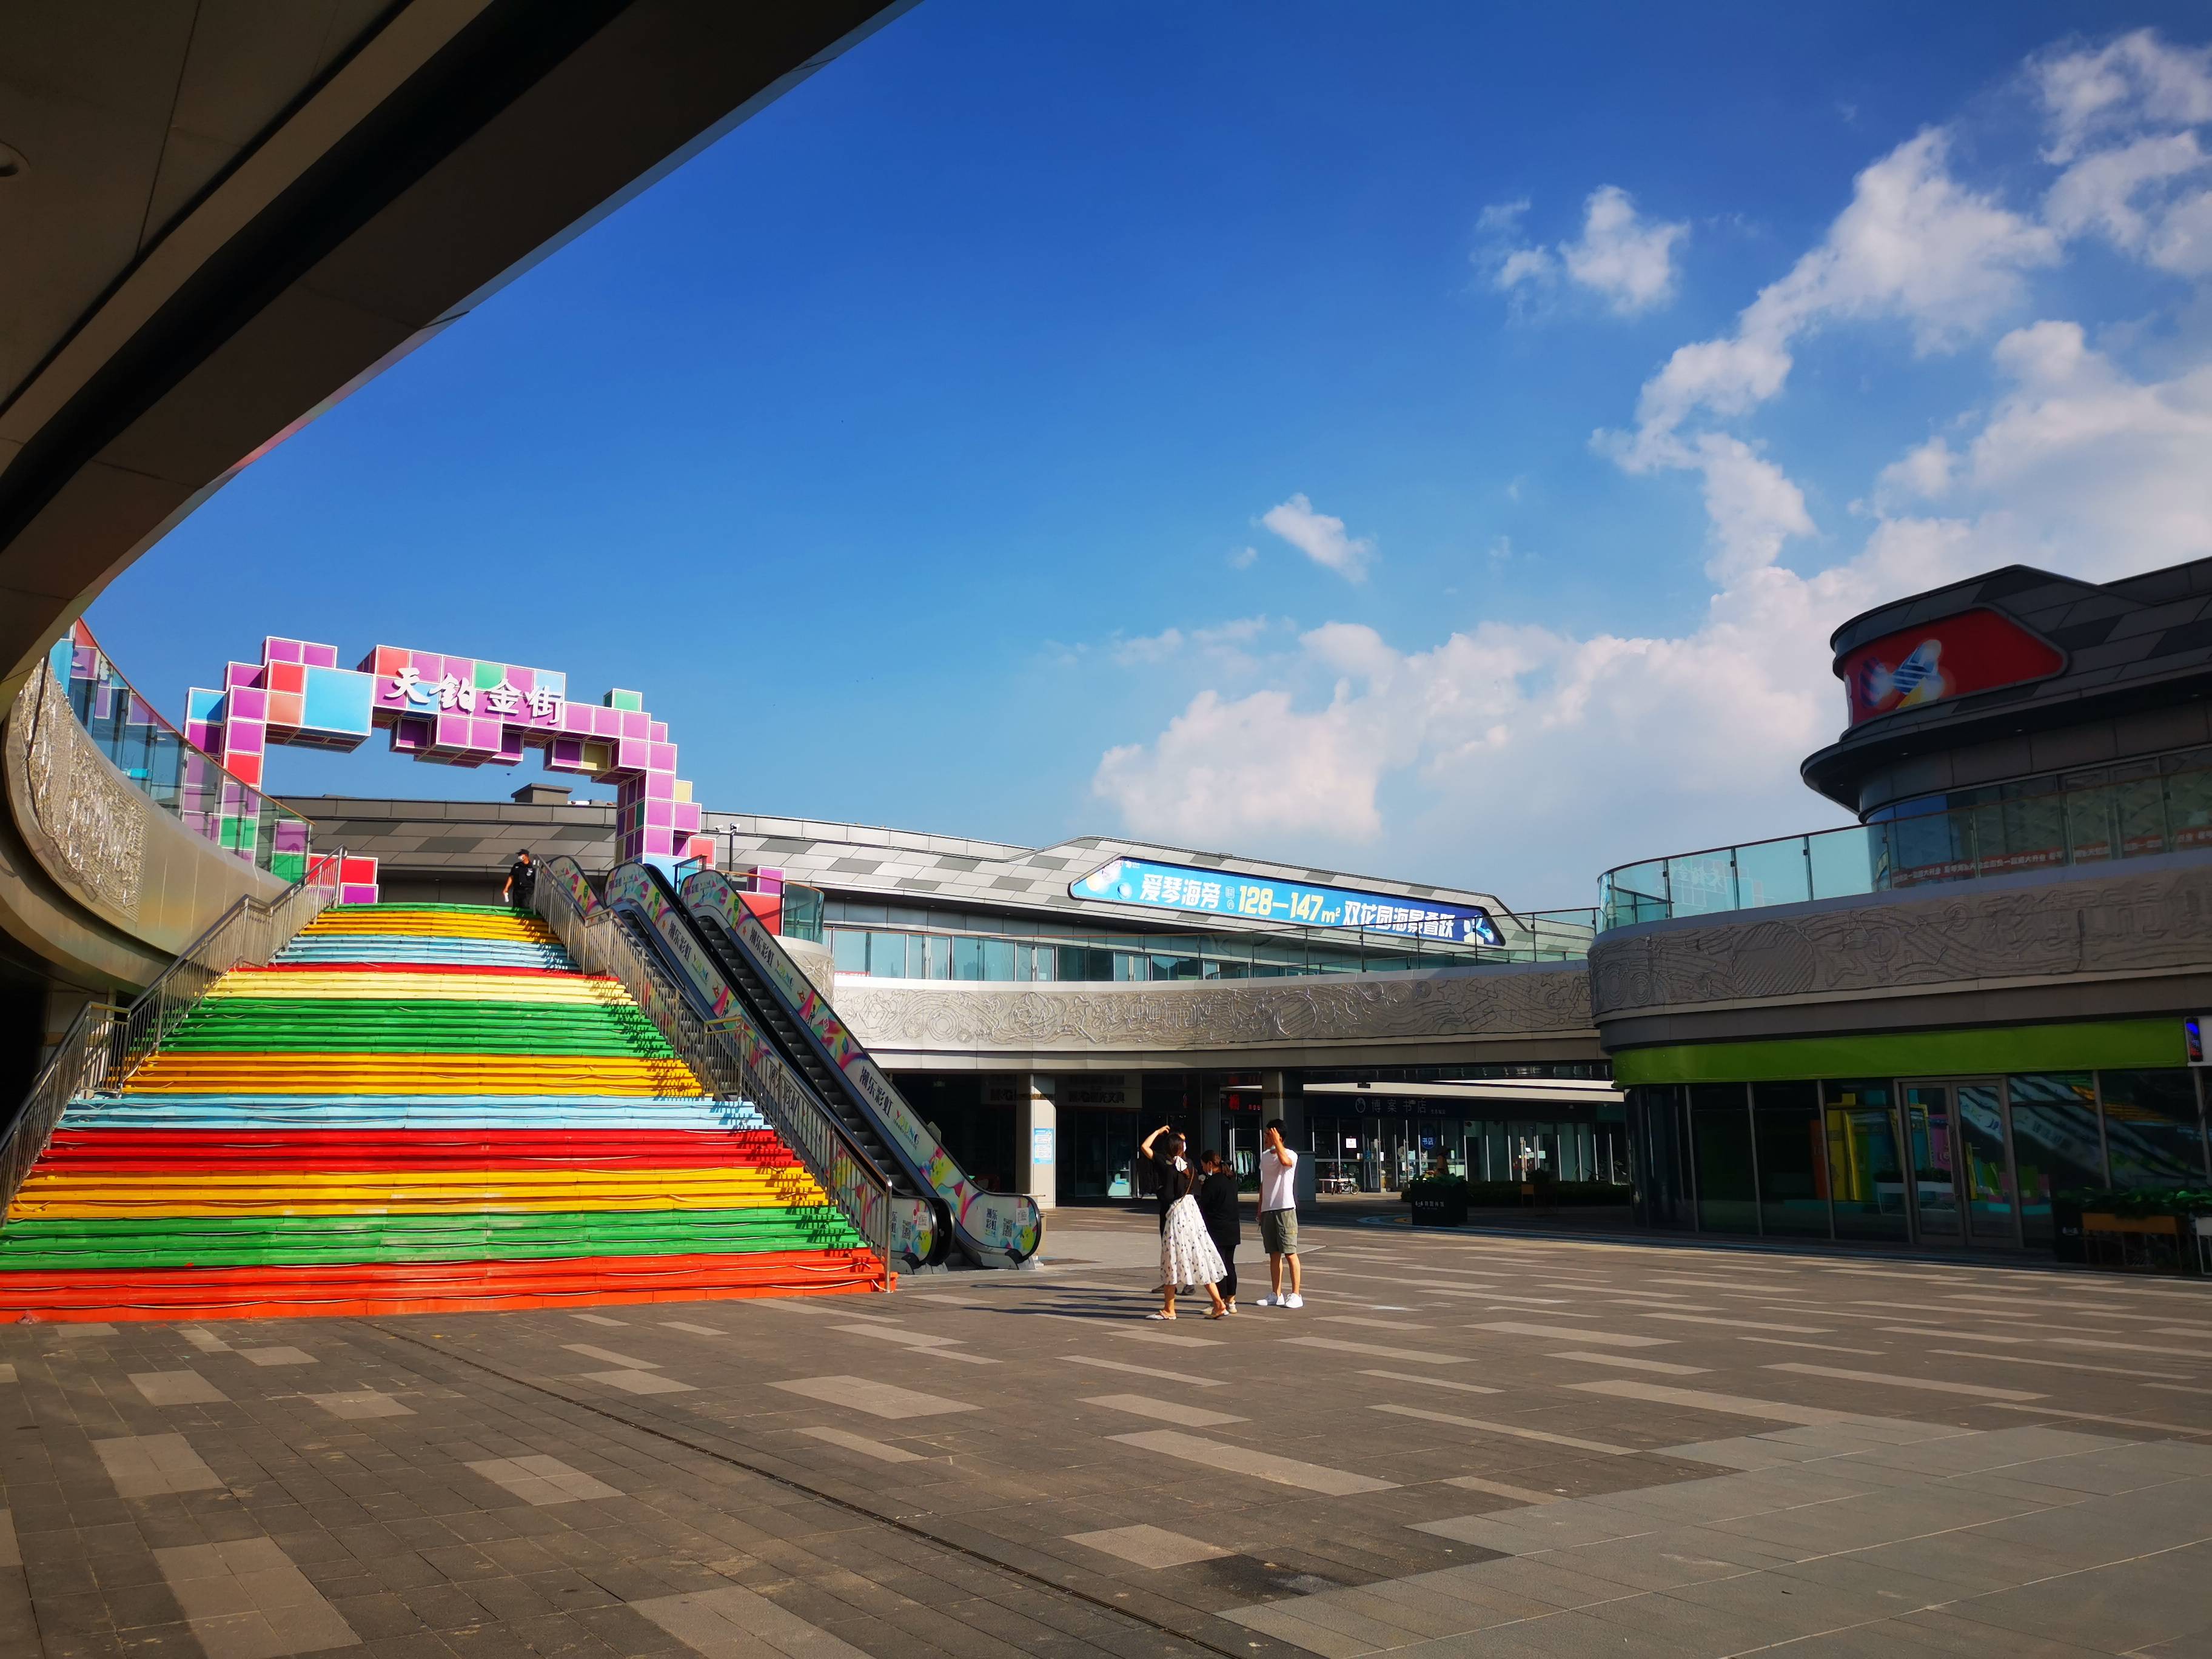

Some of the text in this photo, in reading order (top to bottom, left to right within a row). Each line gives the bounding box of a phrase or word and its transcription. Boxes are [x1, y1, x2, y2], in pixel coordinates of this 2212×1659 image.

[384, 667, 563, 725] 天铂金街
[1139, 874, 1221, 909] 爱琴海旁
[1342, 900, 1455, 938] 双花园海景叠跃
[859, 1066, 894, 1119] 潮乐彩虹
[896, 1109, 920, 1145] YOUNG
[1421, 1137, 1434, 1145] 书店
